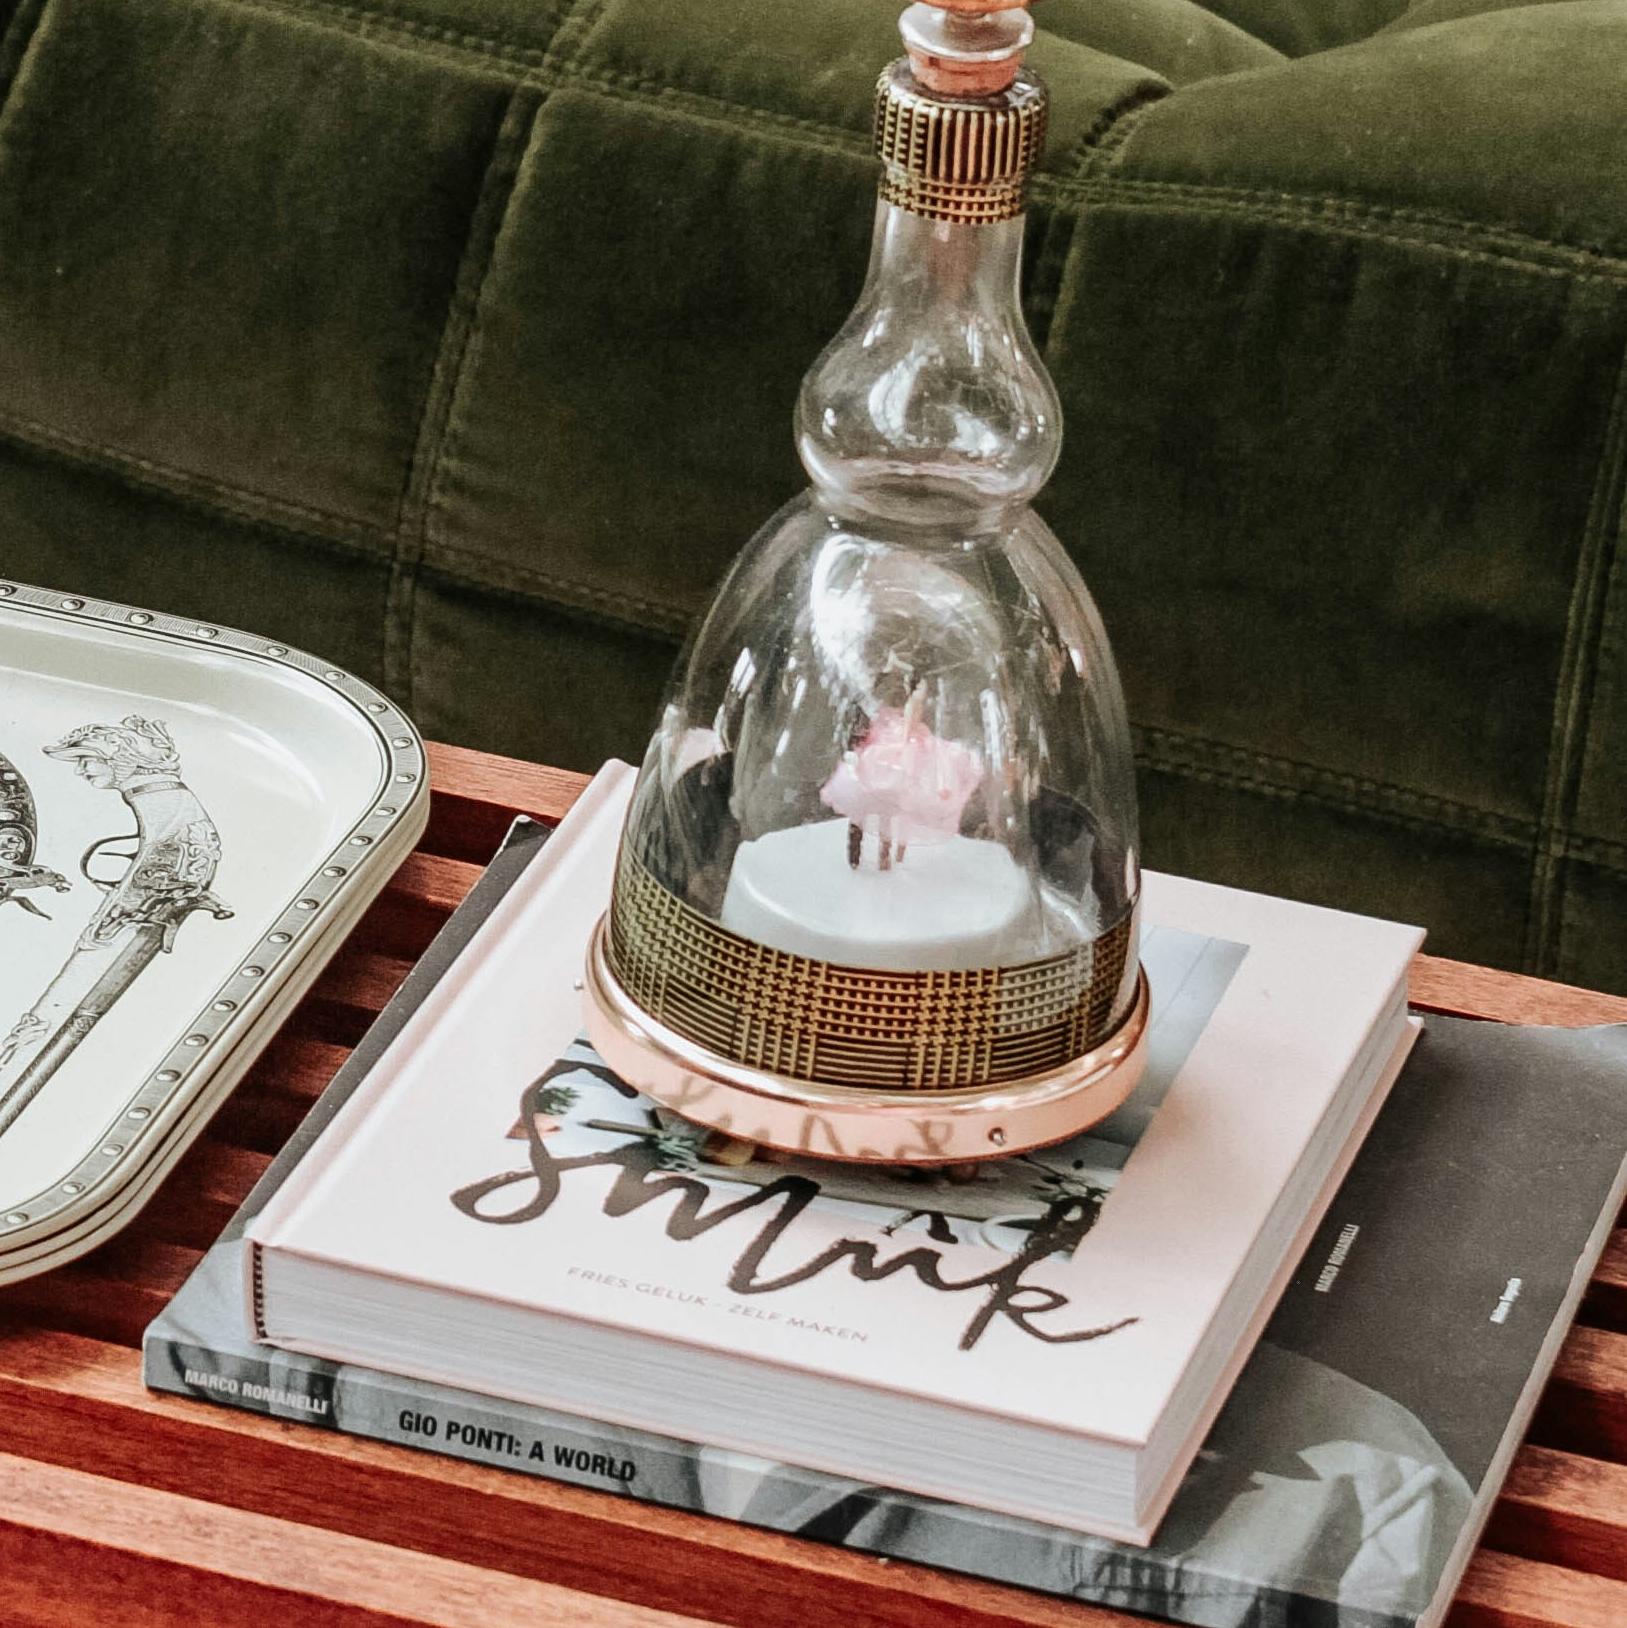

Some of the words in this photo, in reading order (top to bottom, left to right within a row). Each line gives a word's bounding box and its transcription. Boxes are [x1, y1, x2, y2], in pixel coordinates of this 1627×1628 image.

[566, 1266, 629, 1289] FRIES
[635, 1282, 709, 1307] GELUK
[727, 1302, 782, 1321] ZELF
[787, 1316, 869, 1343] MAKEN
[184, 1369, 238, 1394] MARCO
[242, 1381, 329, 1415] ROMANELLI
[399, 1409, 438, 1437] GIO
[446, 1420, 522, 1457] PONTI:
[528, 1440, 545, 1462] A
[554, 1444, 637, 1482] WORLD
